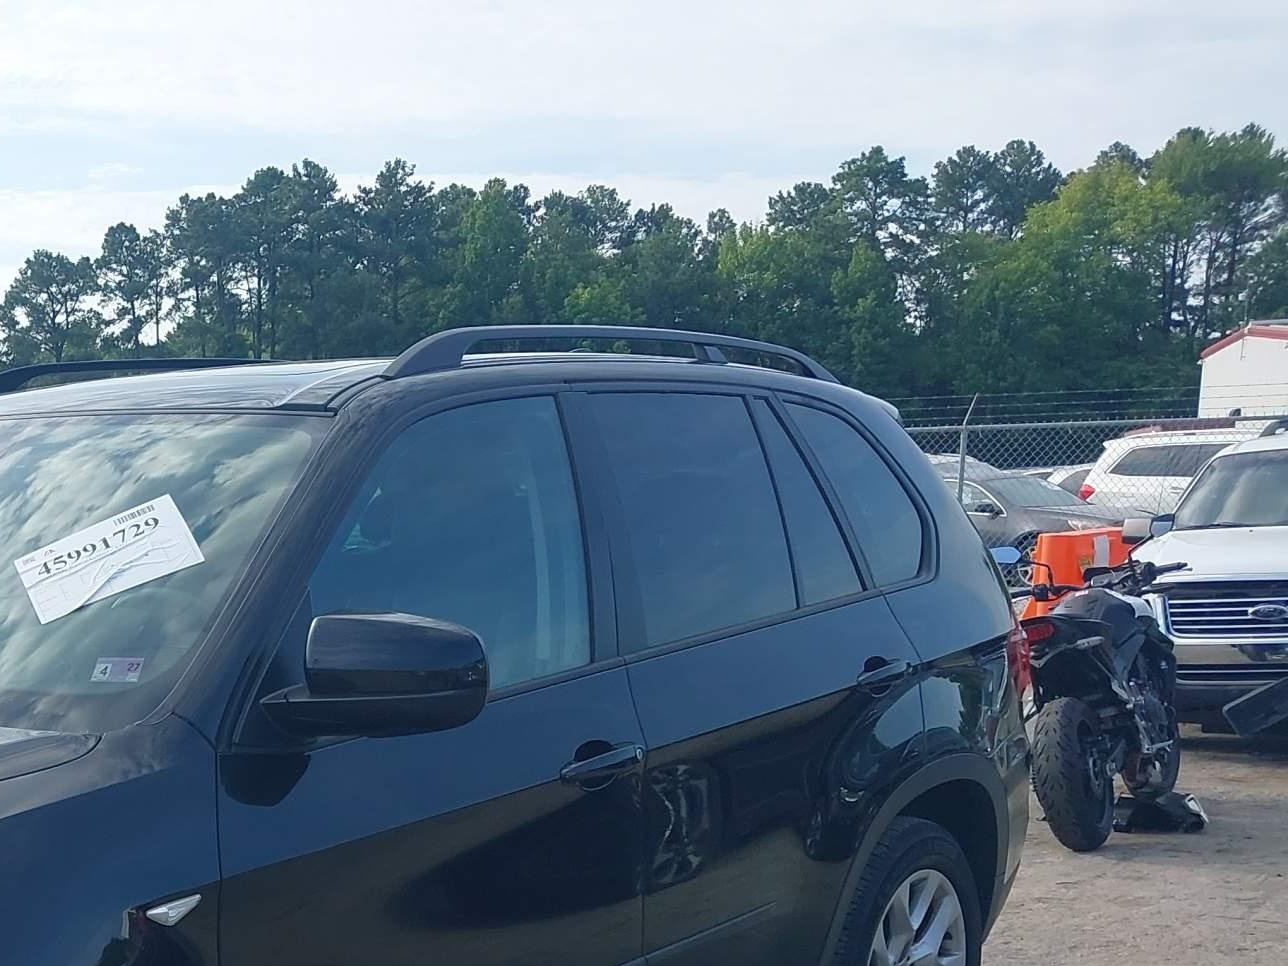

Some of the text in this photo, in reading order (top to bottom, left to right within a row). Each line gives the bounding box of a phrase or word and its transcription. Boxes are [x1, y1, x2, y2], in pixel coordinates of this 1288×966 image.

[38, 516, 159, 575] 45991729
[100, 665, 109, 676] 4
[127, 662, 141, 672] 27
